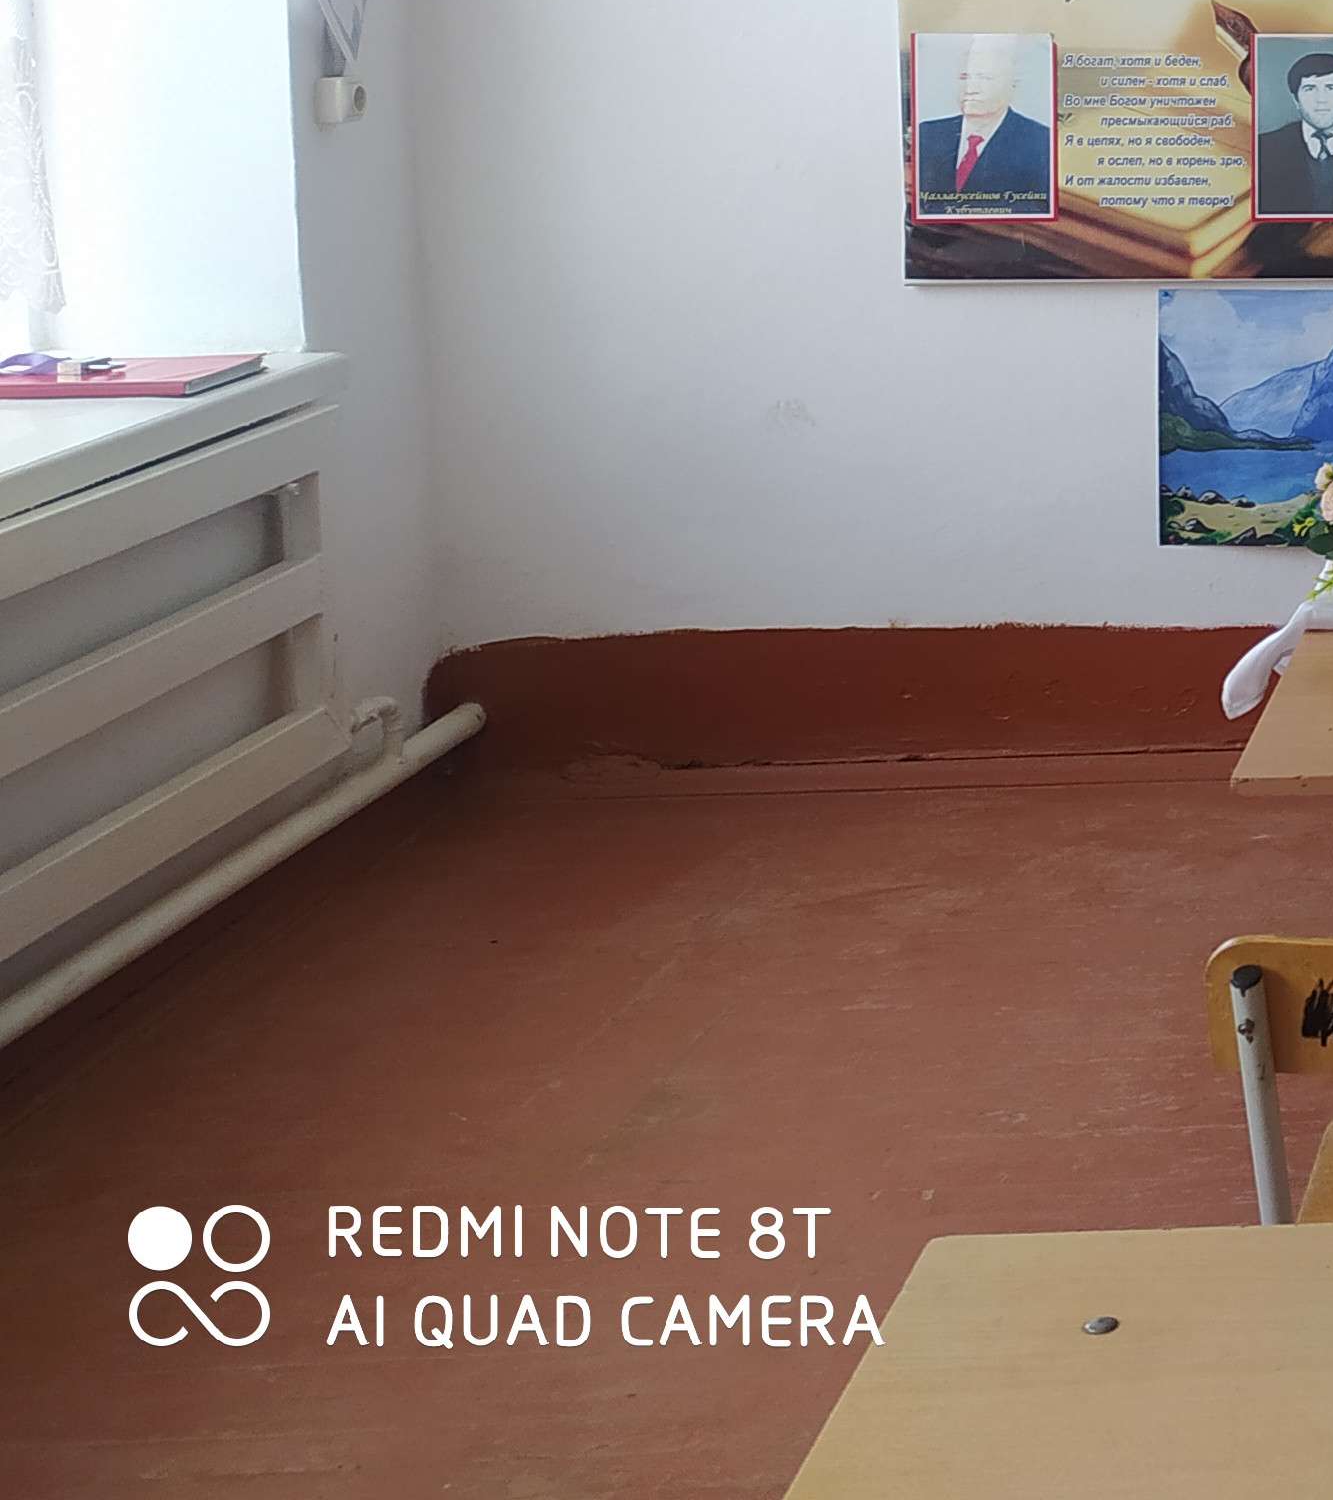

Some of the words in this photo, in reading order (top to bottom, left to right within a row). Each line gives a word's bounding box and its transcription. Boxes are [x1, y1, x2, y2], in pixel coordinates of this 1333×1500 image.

[1075, 55, 1118, 69] богат,
[1119, 57, 1150, 67] хотя
[1164, 55, 1202, 69] беден,
[1110, 77, 1146, 87] силен
[1155, 77, 1186, 87] хотя
[1199, 75, 1230, 88] слаб,
[1064, 95, 1080, 106] Во
[1083, 97, 1106, 106] мне
[1109, 95, 1146, 106] Богом
[1149, 97, 1216, 109] уничтожен
[1100, 115, 1208, 128] пресмыкающийся
[1210, 115, 1235, 128] раб.
[1087, 136, 1124, 148] цепях,
[1127, 137, 1142, 146] но
[1155, 134, 1214, 148] свободен,
[1107, 156, 1146, 167] ослеп,
[1148, 157, 1163, 166] но
[1176, 156, 1217, 167] корень
[1219, 157, 1246, 168] зрю,
[1076, 177, 1095, 186] от
[1098, 176, 1151, 186] жалости
[1154, 174, 1212, 188] избавлен,
[1100, 196, 1148, 208] потому
[1150, 196, 1175, 206] что
[1188, 194, 1235, 208] творю!
